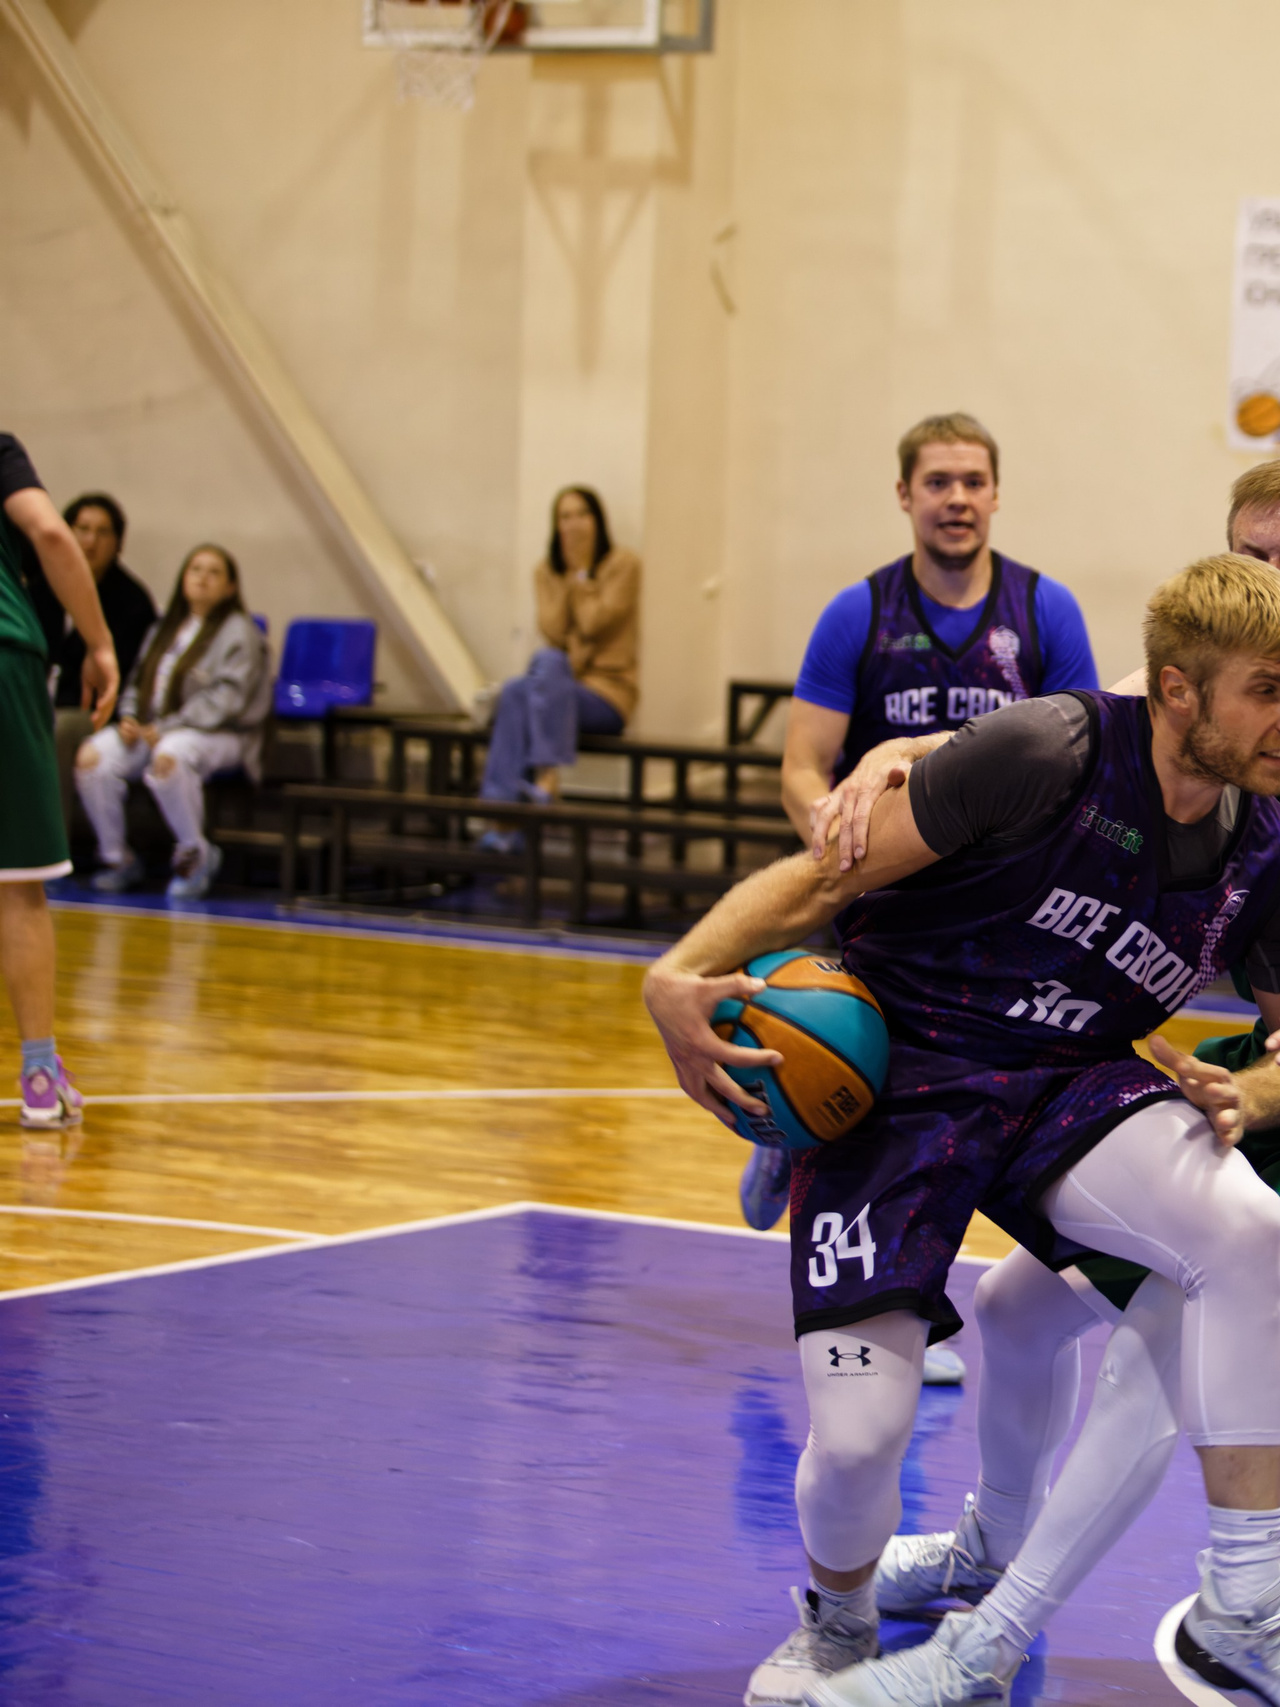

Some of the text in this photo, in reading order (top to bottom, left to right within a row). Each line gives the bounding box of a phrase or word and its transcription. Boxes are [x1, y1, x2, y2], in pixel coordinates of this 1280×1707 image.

[885, 686, 938, 725] ВСЕ
[1025, 887, 1122, 950] ВСЕ
[808, 1202, 876, 1287] 34
